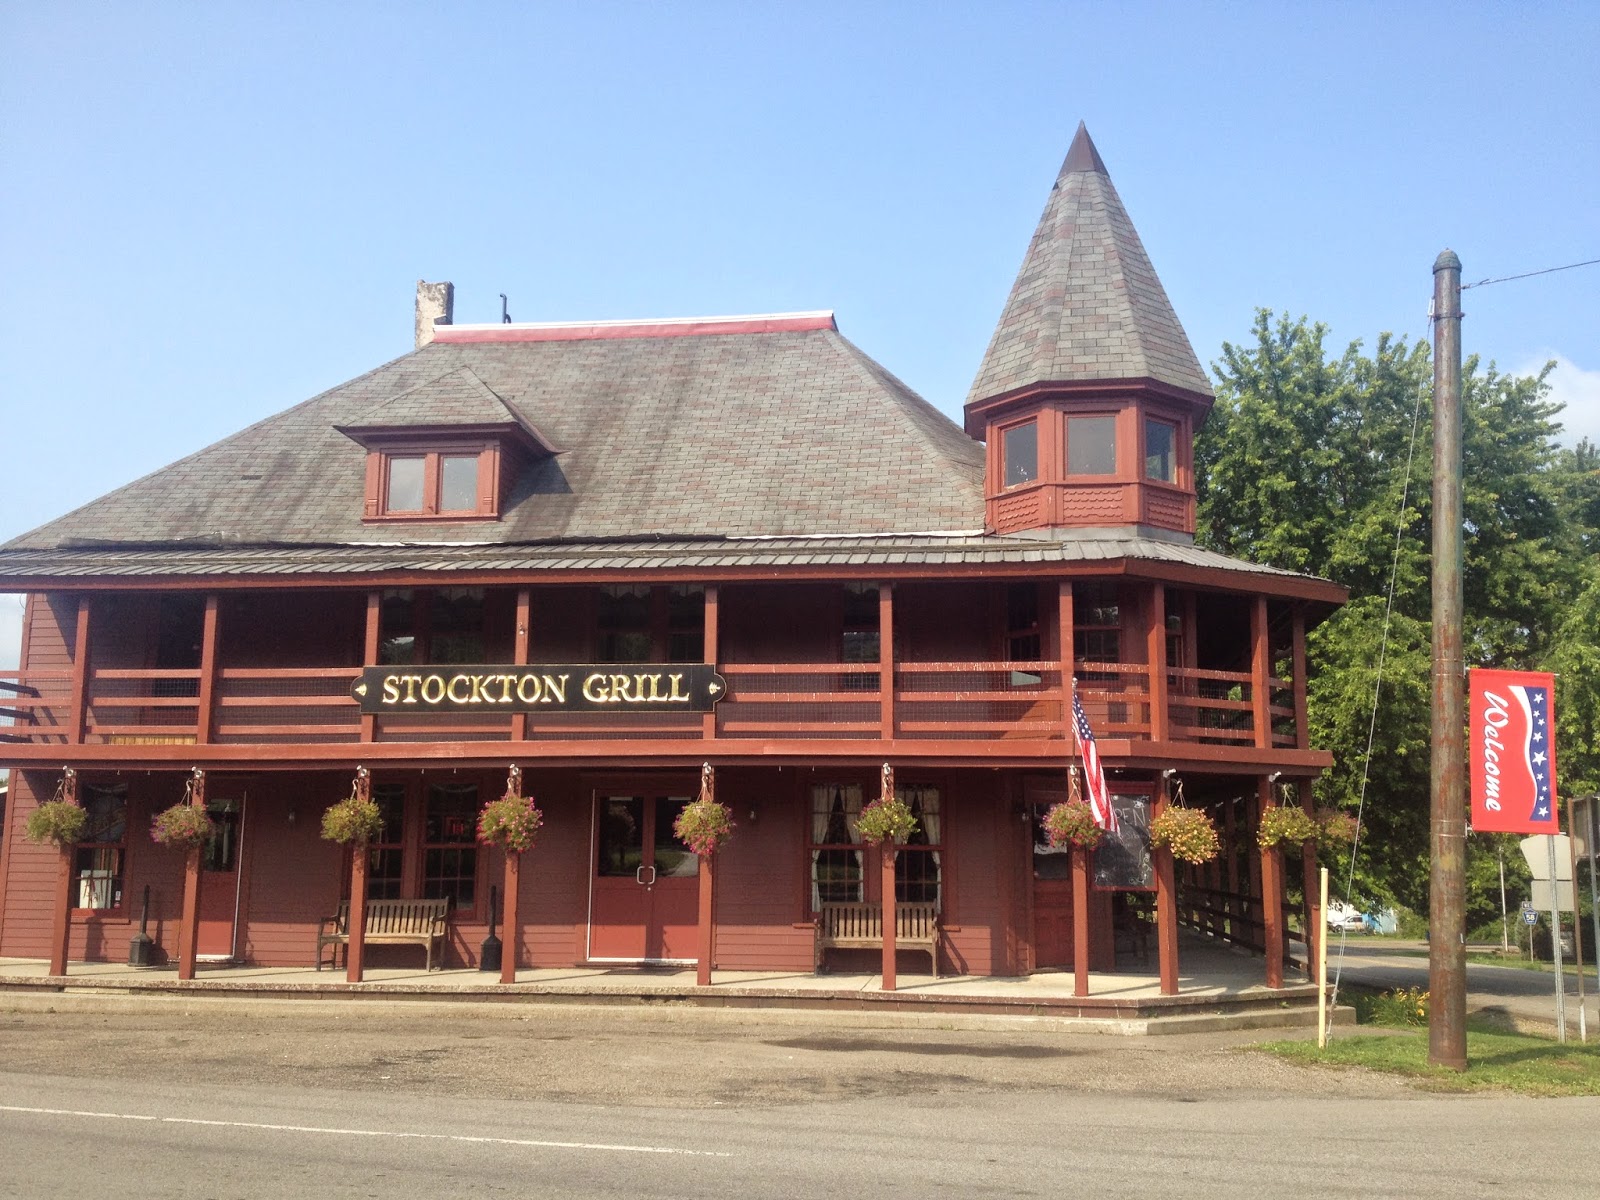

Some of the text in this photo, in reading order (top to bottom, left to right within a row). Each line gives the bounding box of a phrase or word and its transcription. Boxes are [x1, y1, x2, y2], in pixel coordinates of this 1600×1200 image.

[382, 673, 690, 703] STOCKTON GRILL
[1484, 690, 1509, 811] Welcome
[1114, 807, 1146, 826] PEN
